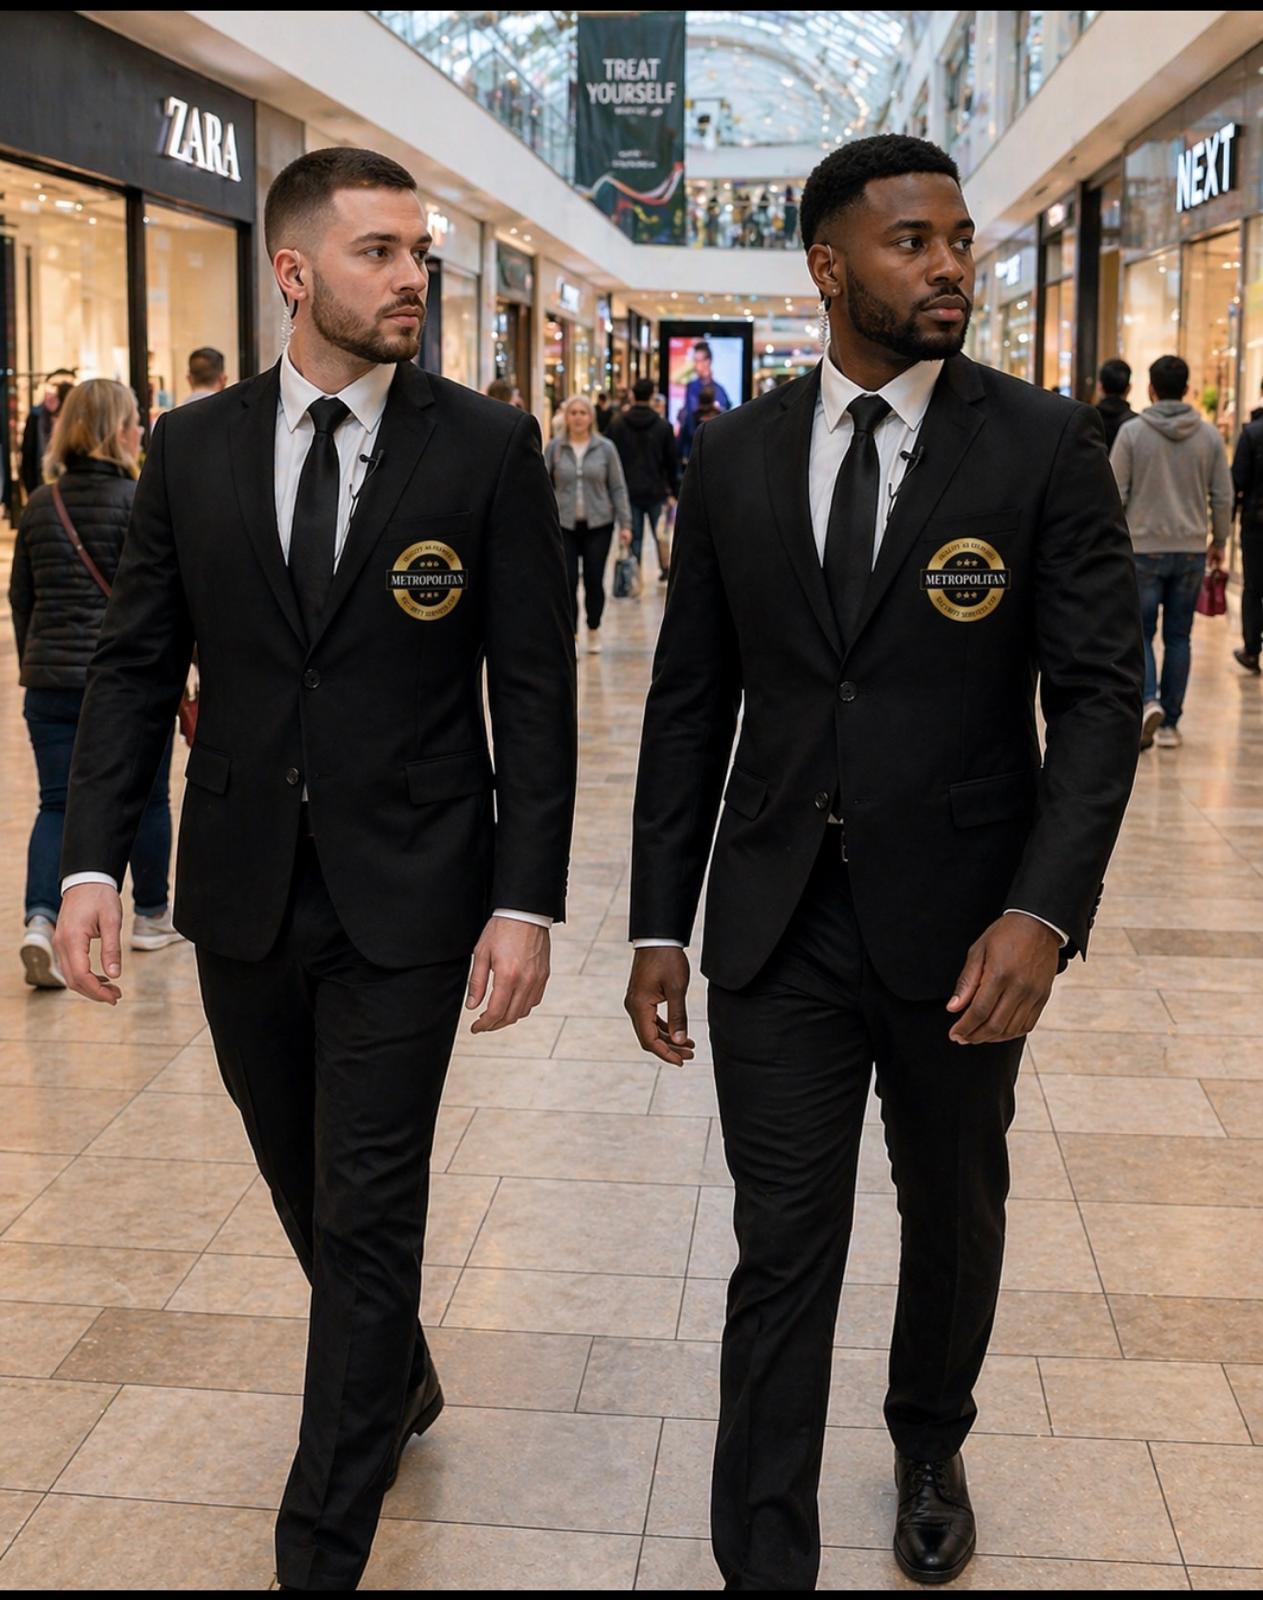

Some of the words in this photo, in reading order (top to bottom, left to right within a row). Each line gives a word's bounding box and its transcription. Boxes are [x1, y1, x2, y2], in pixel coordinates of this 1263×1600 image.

[602, 58, 661, 80] TREAT
[586, 81, 677, 104] YOURSELF
[164, 96, 242, 182] ZARA
[1176, 122, 1235, 213] NEXT
[391, 574, 464, 586] METROPOLITAN
[925, 573, 1006, 585] METROPOLITAN
